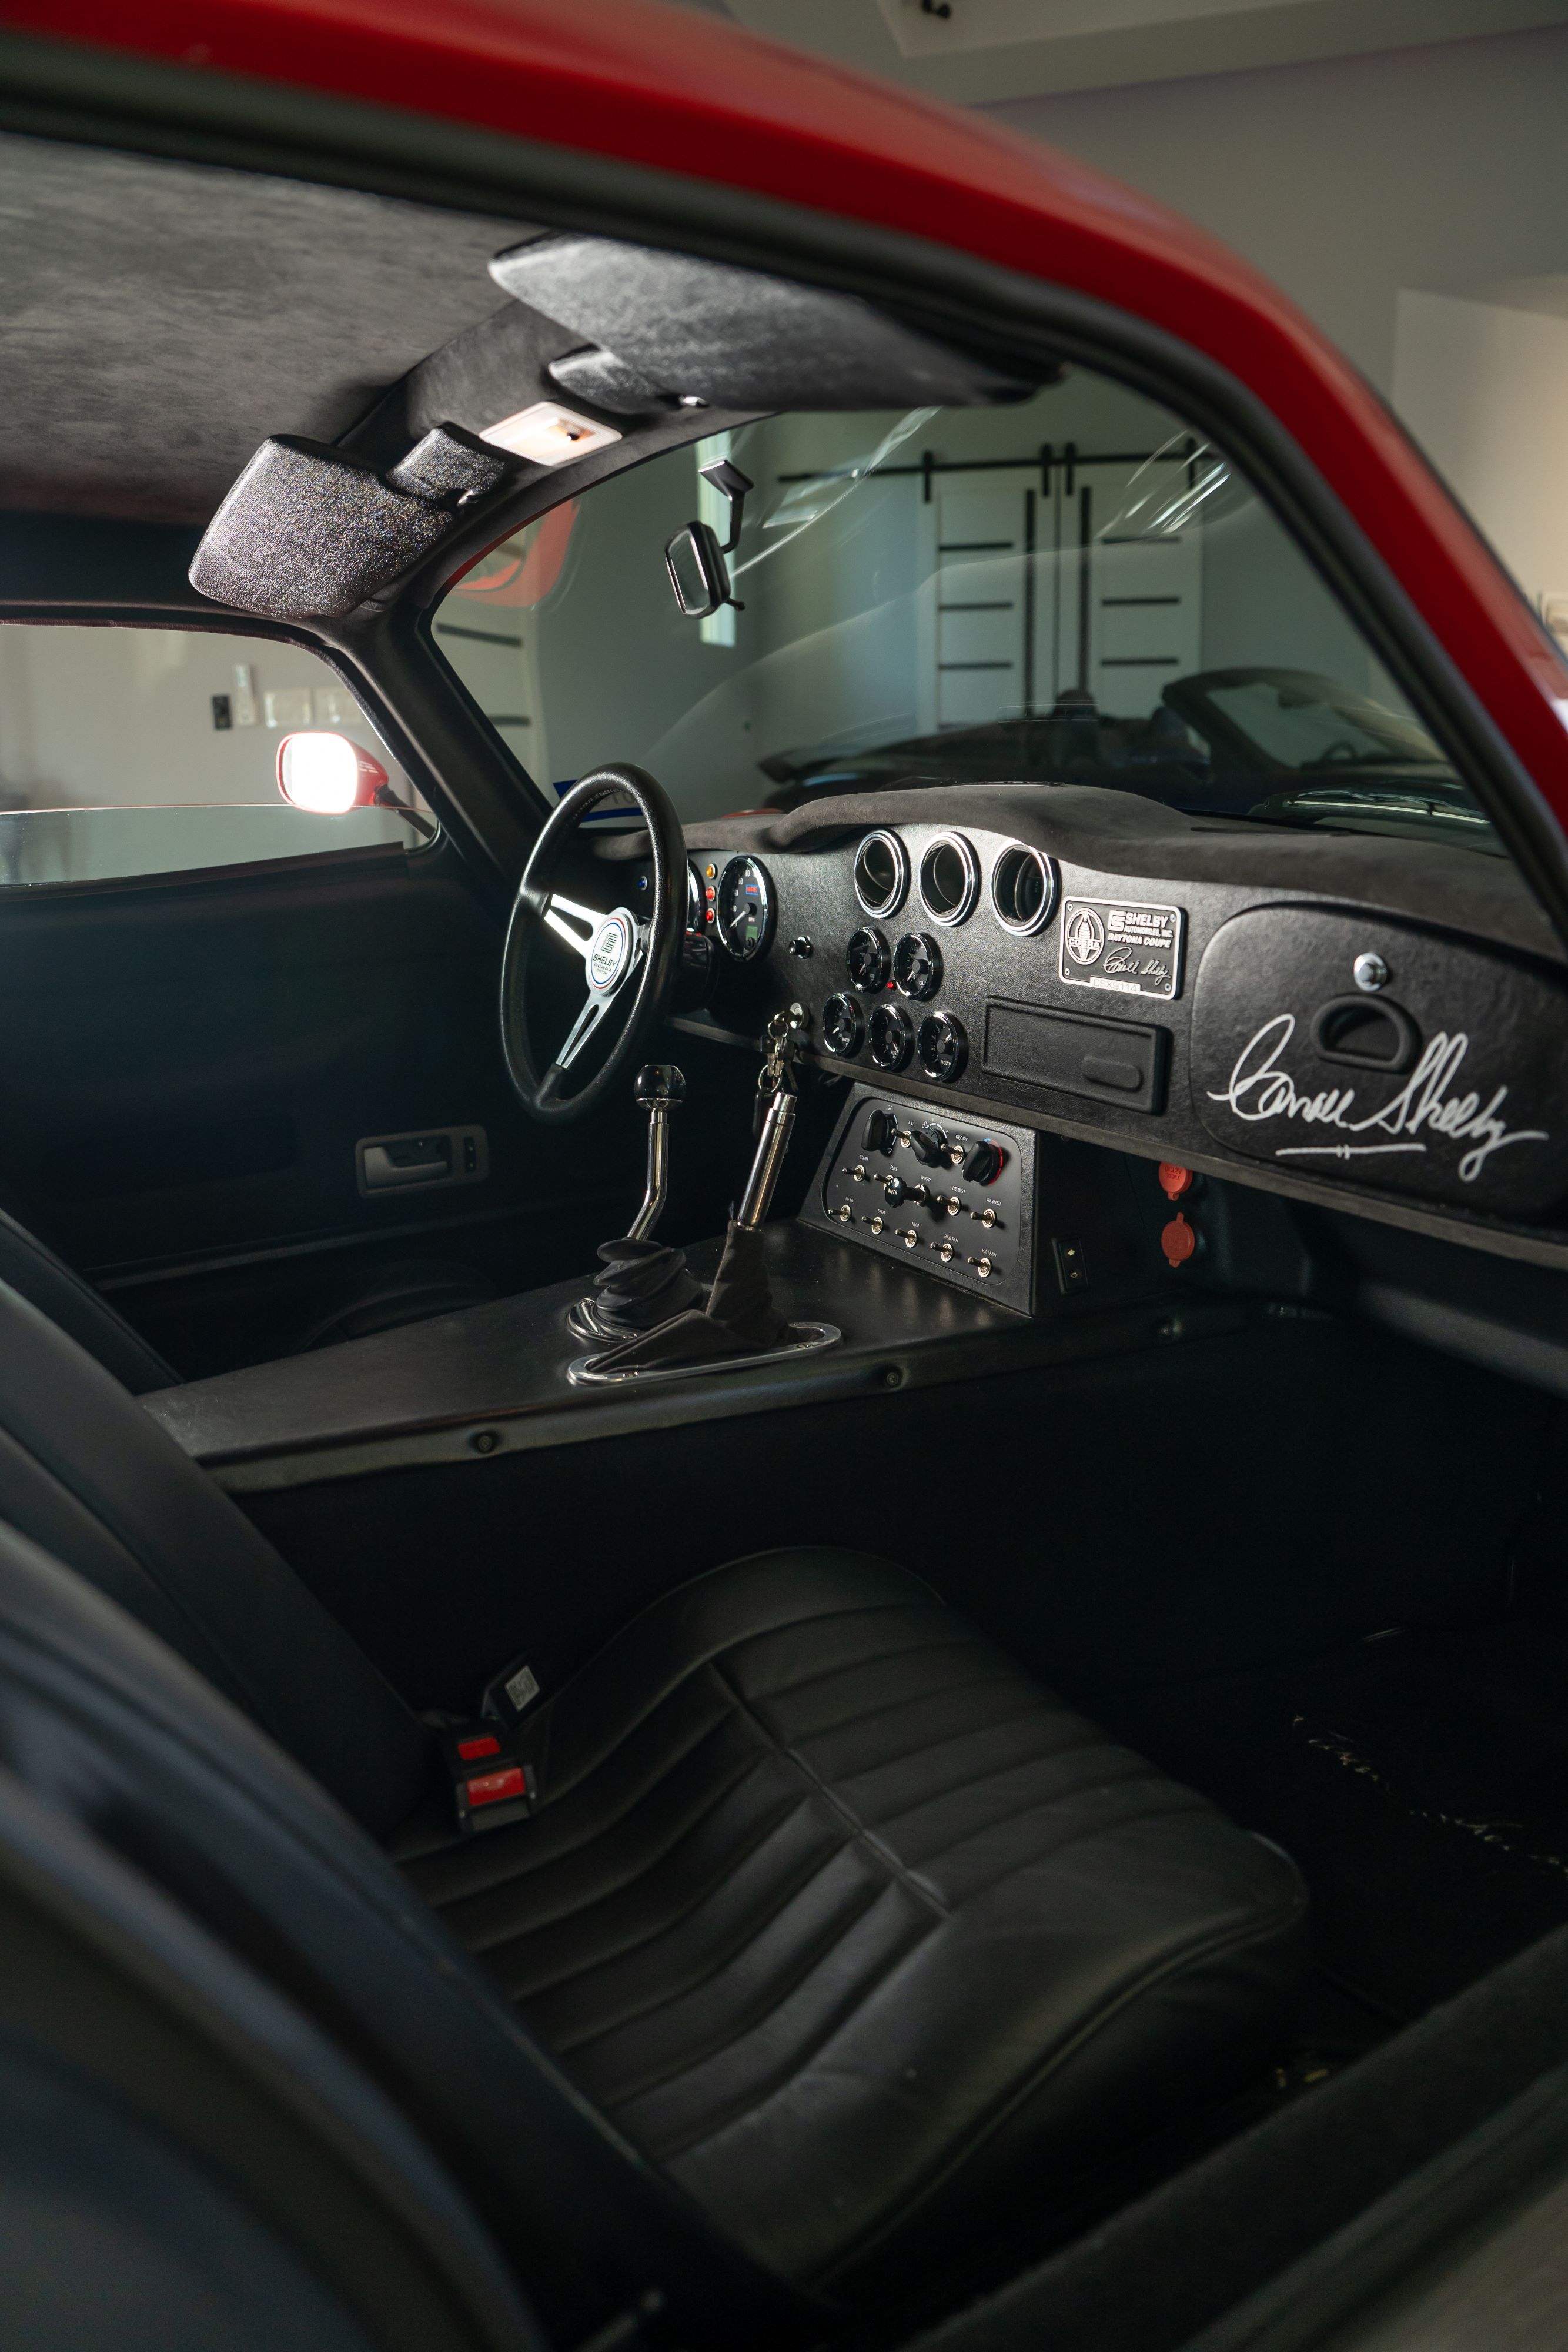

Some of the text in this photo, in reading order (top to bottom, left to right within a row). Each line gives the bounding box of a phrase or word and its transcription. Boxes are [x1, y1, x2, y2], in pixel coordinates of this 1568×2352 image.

[1125, 912, 1169, 928] SHELBY
[1124, 926, 1174, 938] AUTOMOBILES, INC.
[1068, 938, 1101, 949] COBRA
[1107, 933, 1172, 948] DAYTONA COUPE
[593, 954, 617, 967] SHELBY
[594, 963, 612, 973] COBRA
[1092, 977, 1137, 993] CSX9114
[955, 1134, 969, 1142] RECIRC
[952, 1185, 966, 1194] DE-MIST
[986, 1197, 1001, 1206] WASHER
